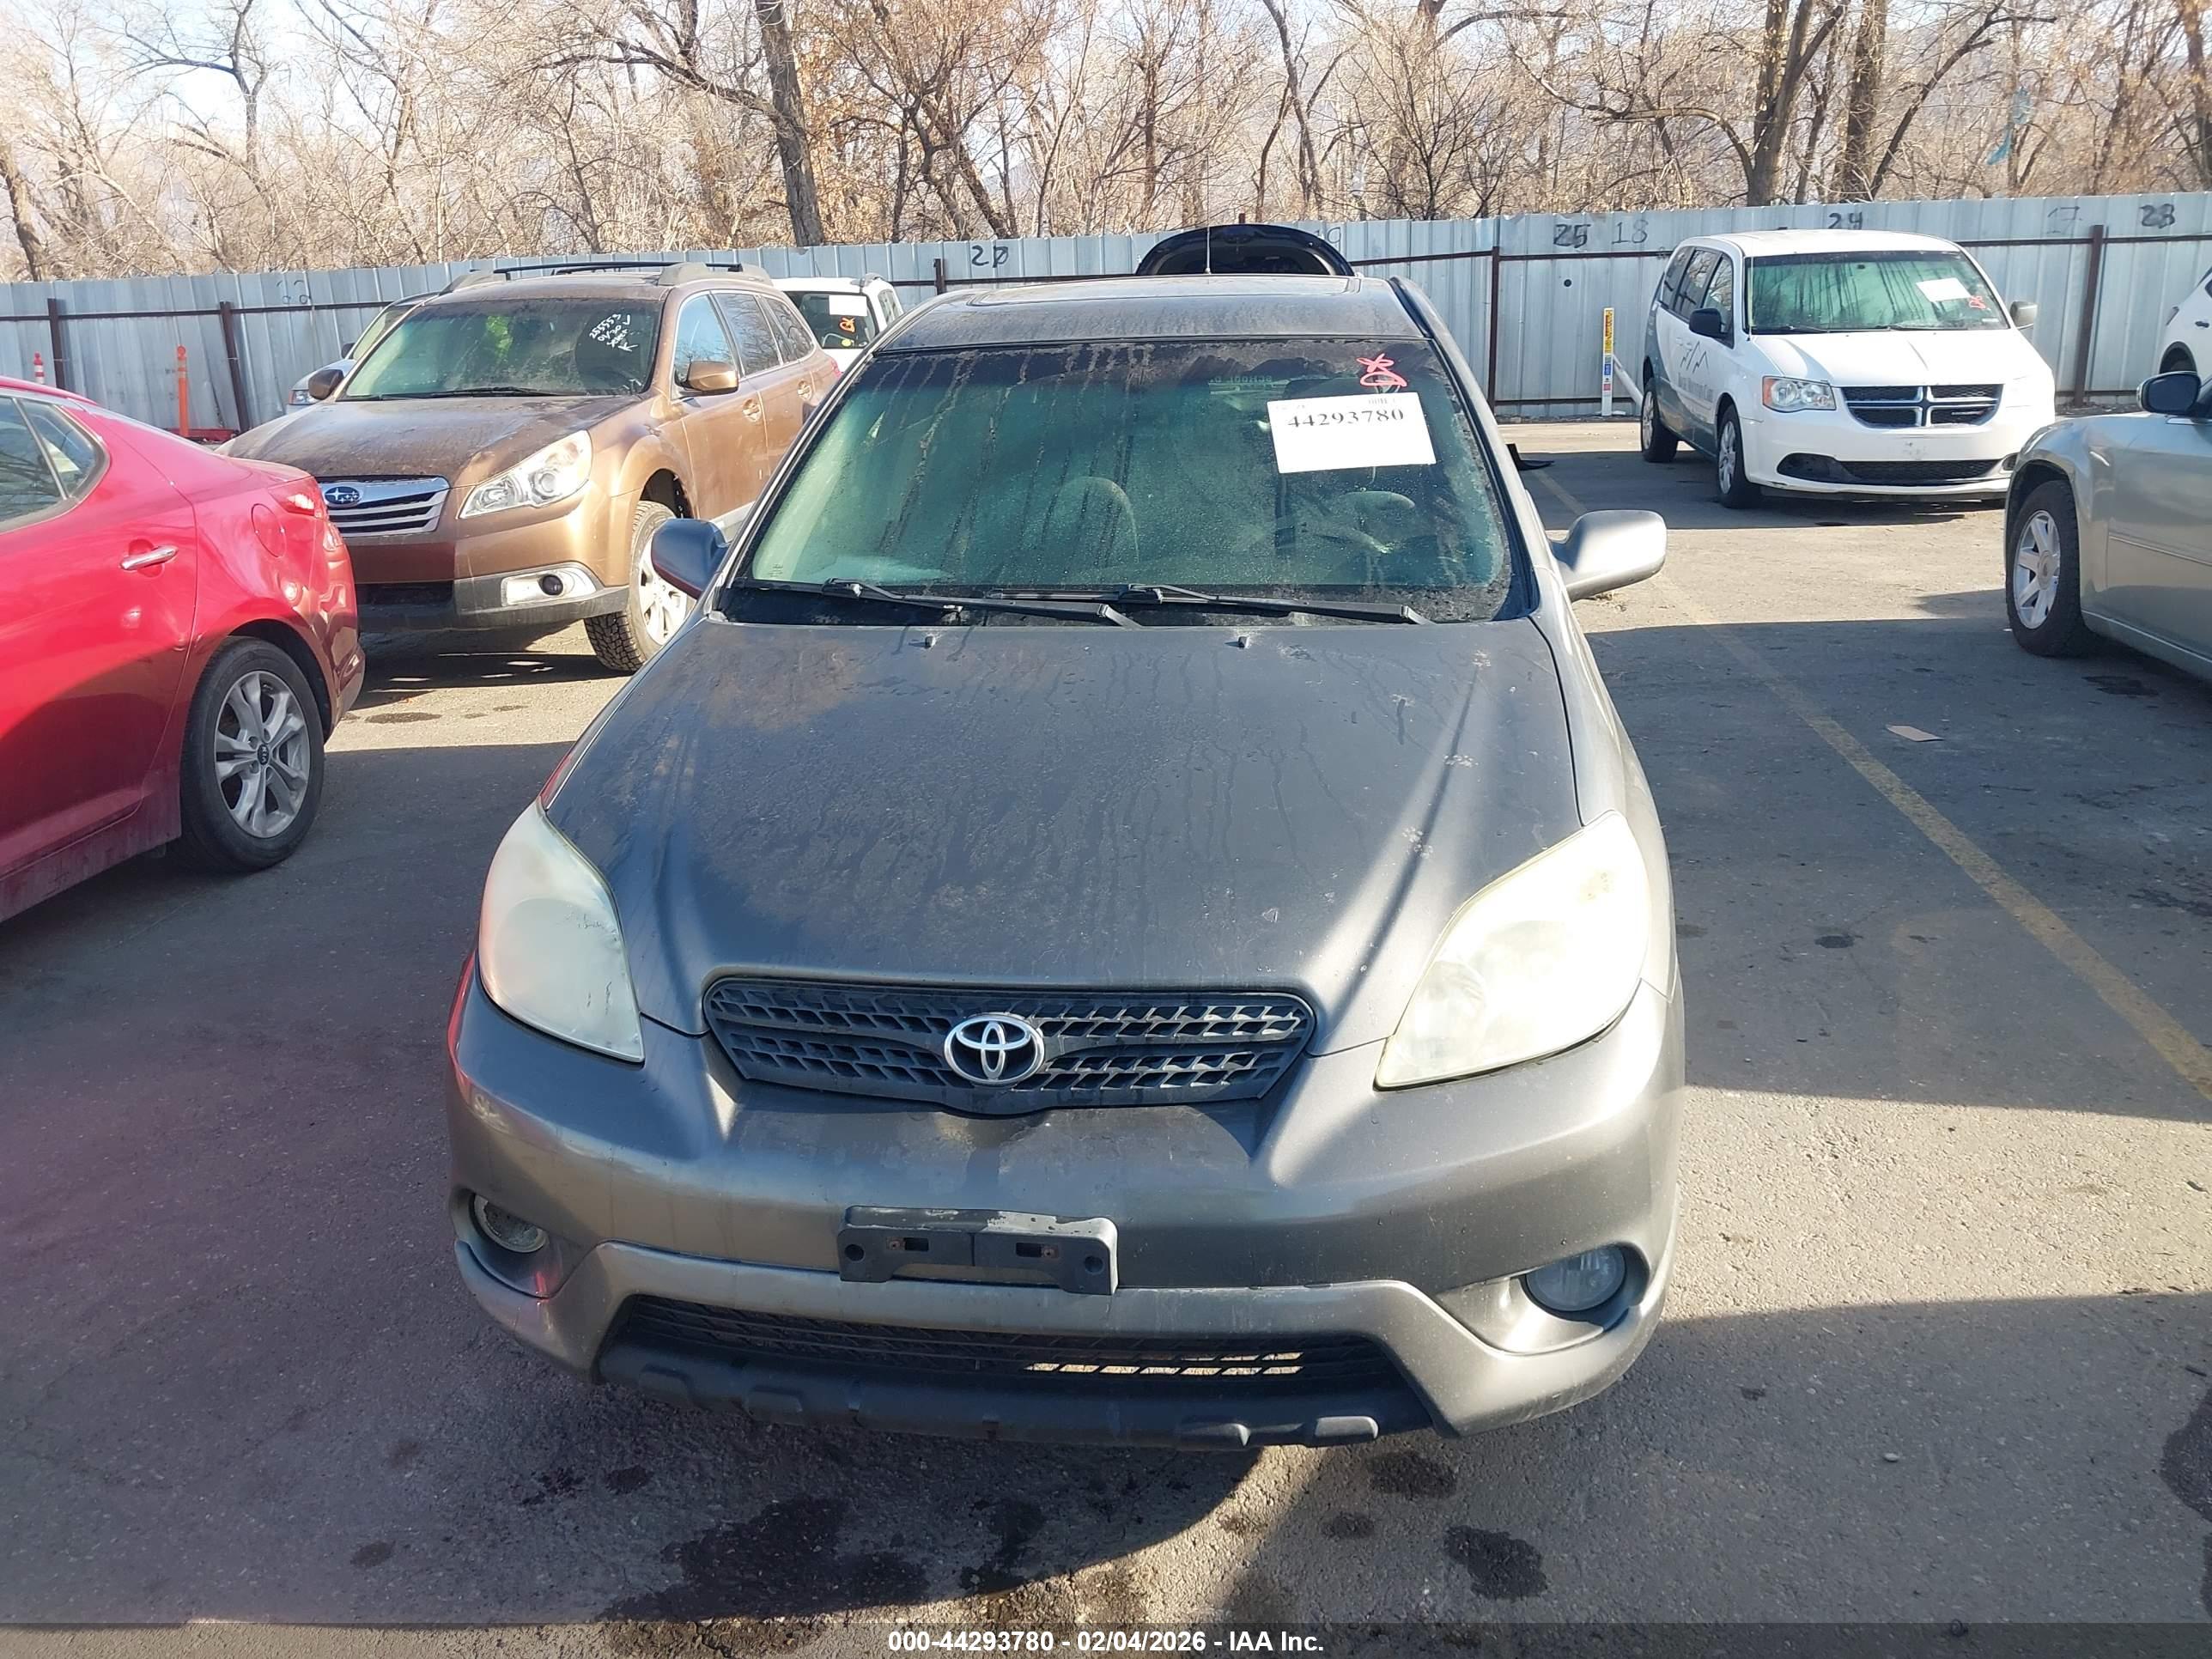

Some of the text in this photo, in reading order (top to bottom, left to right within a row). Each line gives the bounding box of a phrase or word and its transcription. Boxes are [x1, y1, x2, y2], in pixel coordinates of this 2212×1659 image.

[1553, 223, 1591, 249] 25
[1611, 219, 1649, 245] 18
[1288, 408, 1404, 428] 44293780
